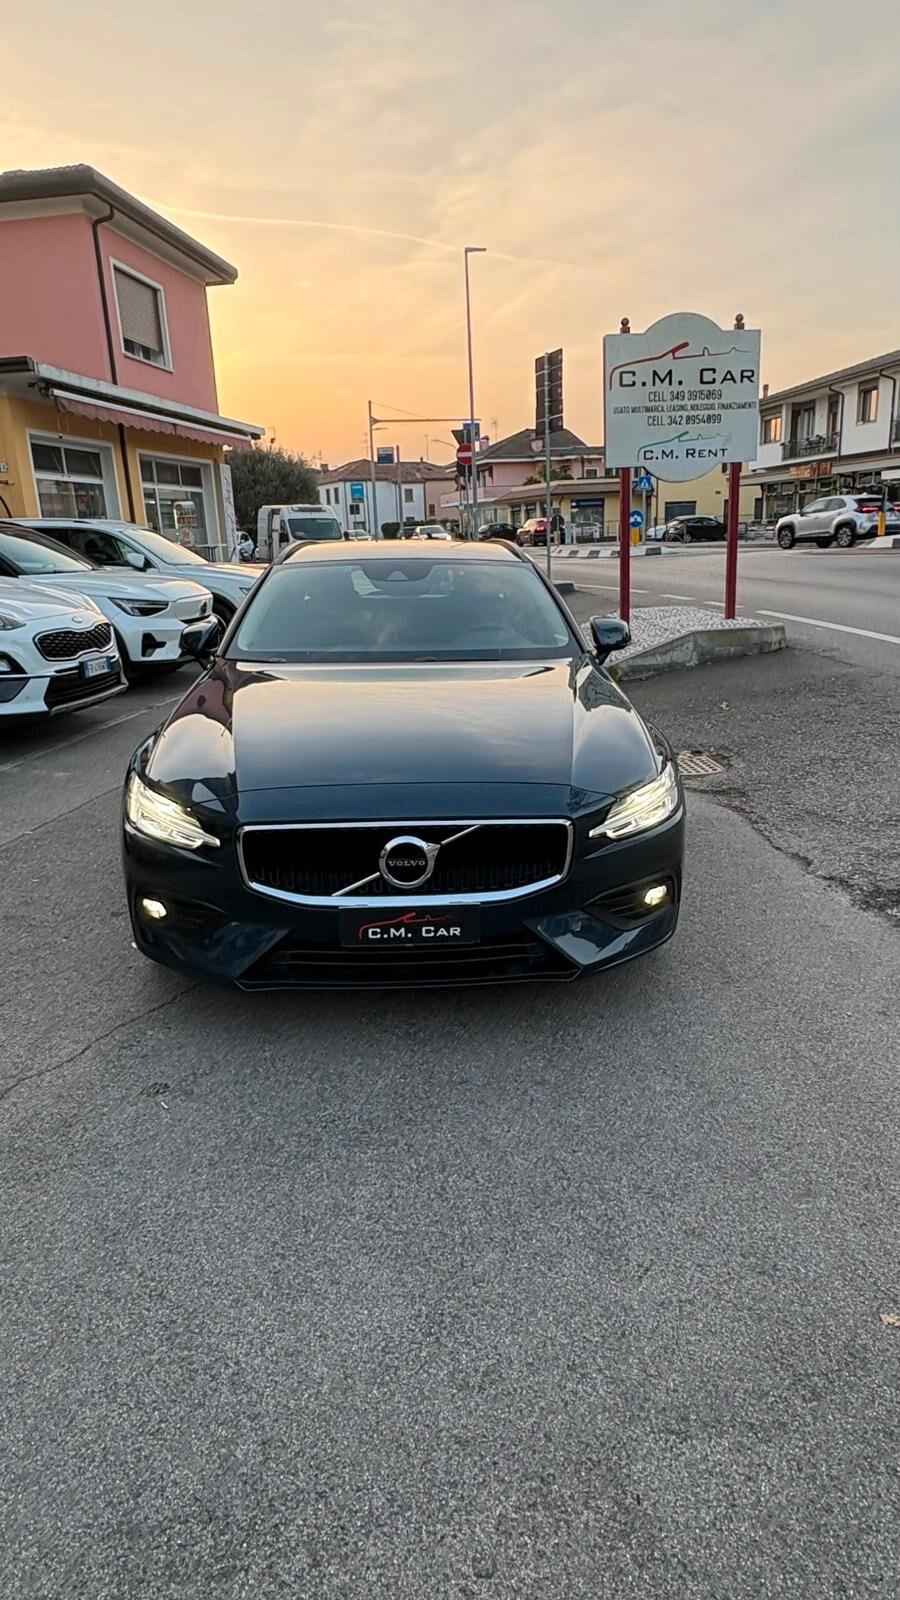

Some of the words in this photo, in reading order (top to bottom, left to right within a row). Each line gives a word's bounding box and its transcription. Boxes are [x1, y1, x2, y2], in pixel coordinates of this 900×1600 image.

[619, 369, 683, 387] C.M.
[699, 368, 755, 385] CAR
[669, 391, 685, 402] 349
[687, 389, 722, 401] 3915069
[613, 406, 630, 415] USATO
[717, 401, 757, 411] FINANZIAMENTI
[667, 415, 683, 426] 342
[685, 413, 722, 425] 0954099
[643, 449, 679, 461] C.M.
[685, 447, 728, 458] RENT
[368, 927, 412, 939] C.M.
[421, 926, 461, 937] CAR
